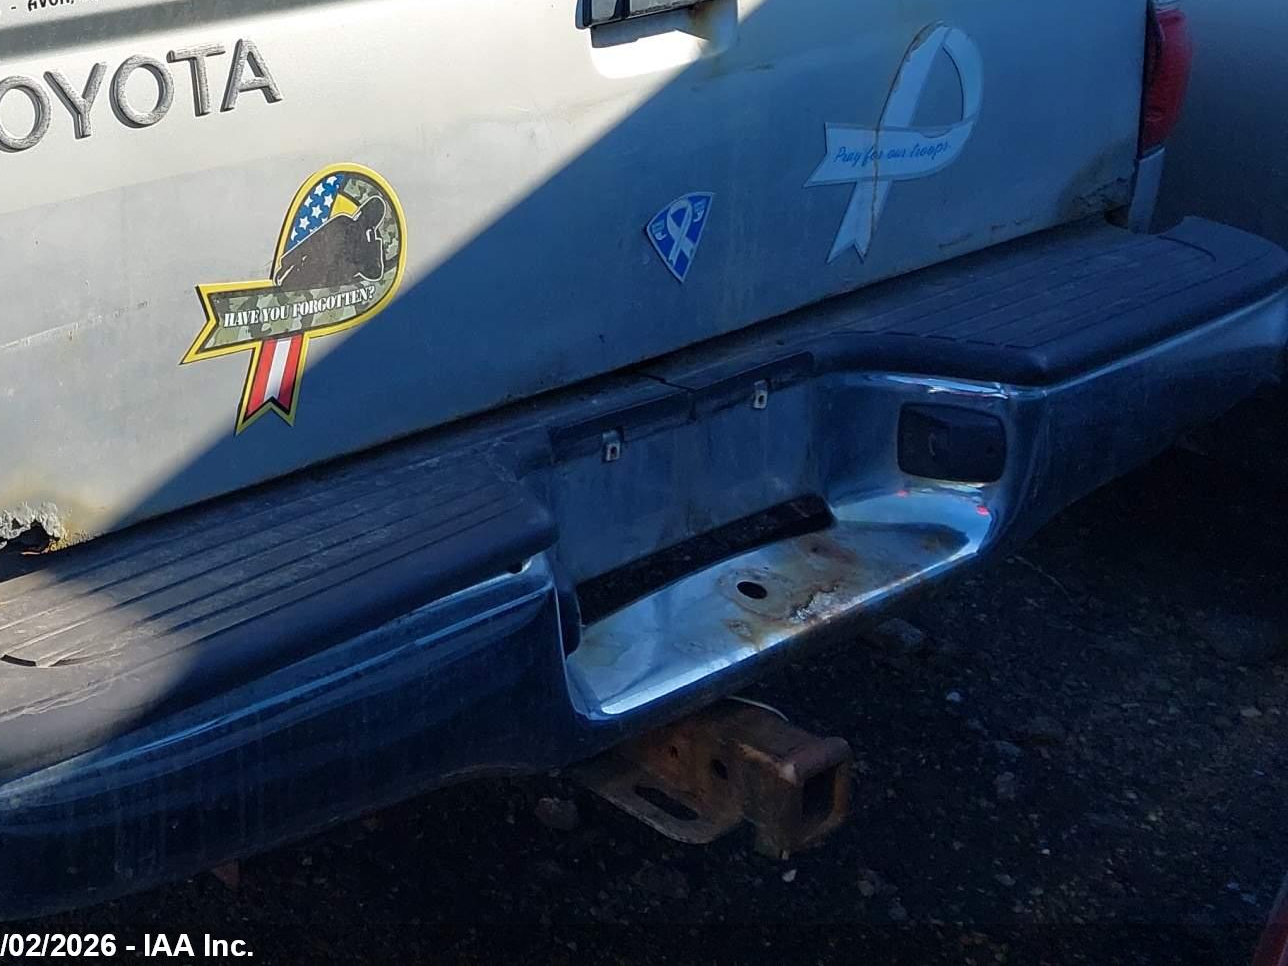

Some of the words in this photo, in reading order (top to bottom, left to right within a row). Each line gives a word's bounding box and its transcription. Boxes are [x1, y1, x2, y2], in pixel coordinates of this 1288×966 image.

[833, 145, 862, 167] Pray
[861, 146, 883, 167] for
[887, 149, 907, 160] our
[223, 310, 260, 328] HAVE
[262, 304, 290, 323] YOU
[292, 285, 376, 319] FORGOTTEN?
